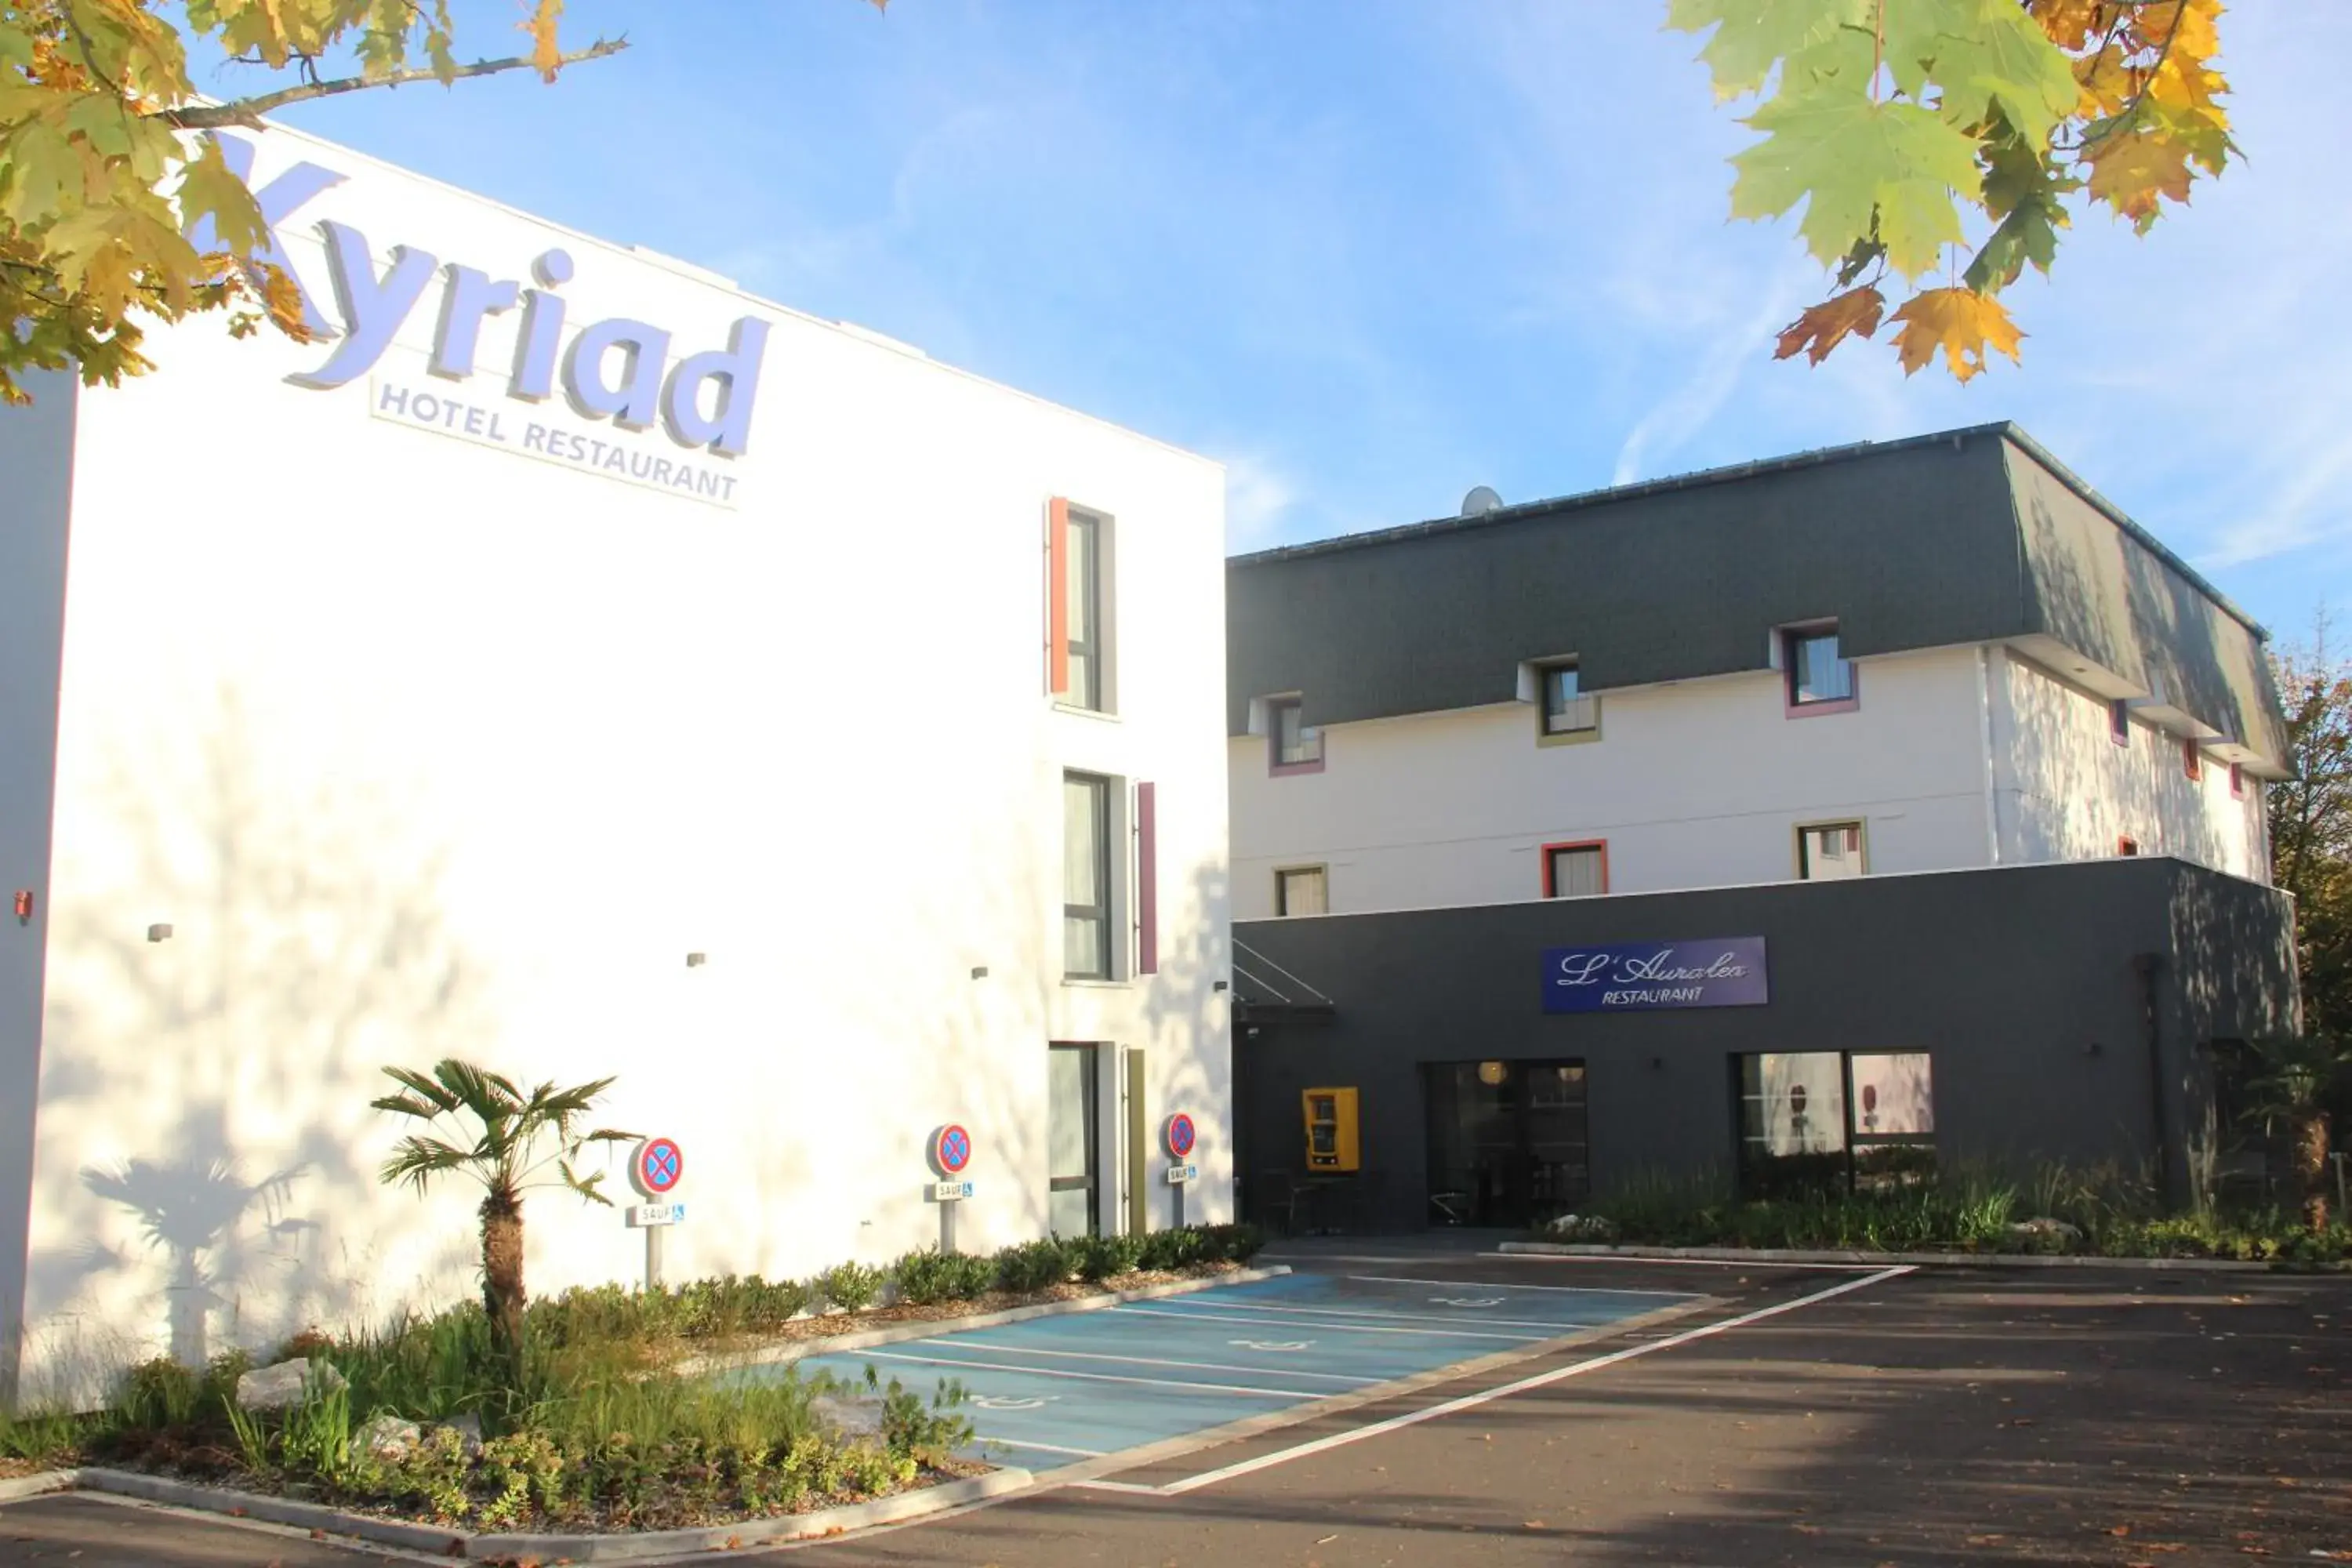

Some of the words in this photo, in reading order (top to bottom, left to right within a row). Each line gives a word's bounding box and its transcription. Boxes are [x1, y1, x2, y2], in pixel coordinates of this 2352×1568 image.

[181, 129, 771, 459] Kyriad
[379, 383, 506, 441] HOTEL
[523, 421, 738, 501] RESTAURANT
[1602, 985, 1704, 1005] RESTAURANT
[642, 1207, 670, 1220] SAUF
